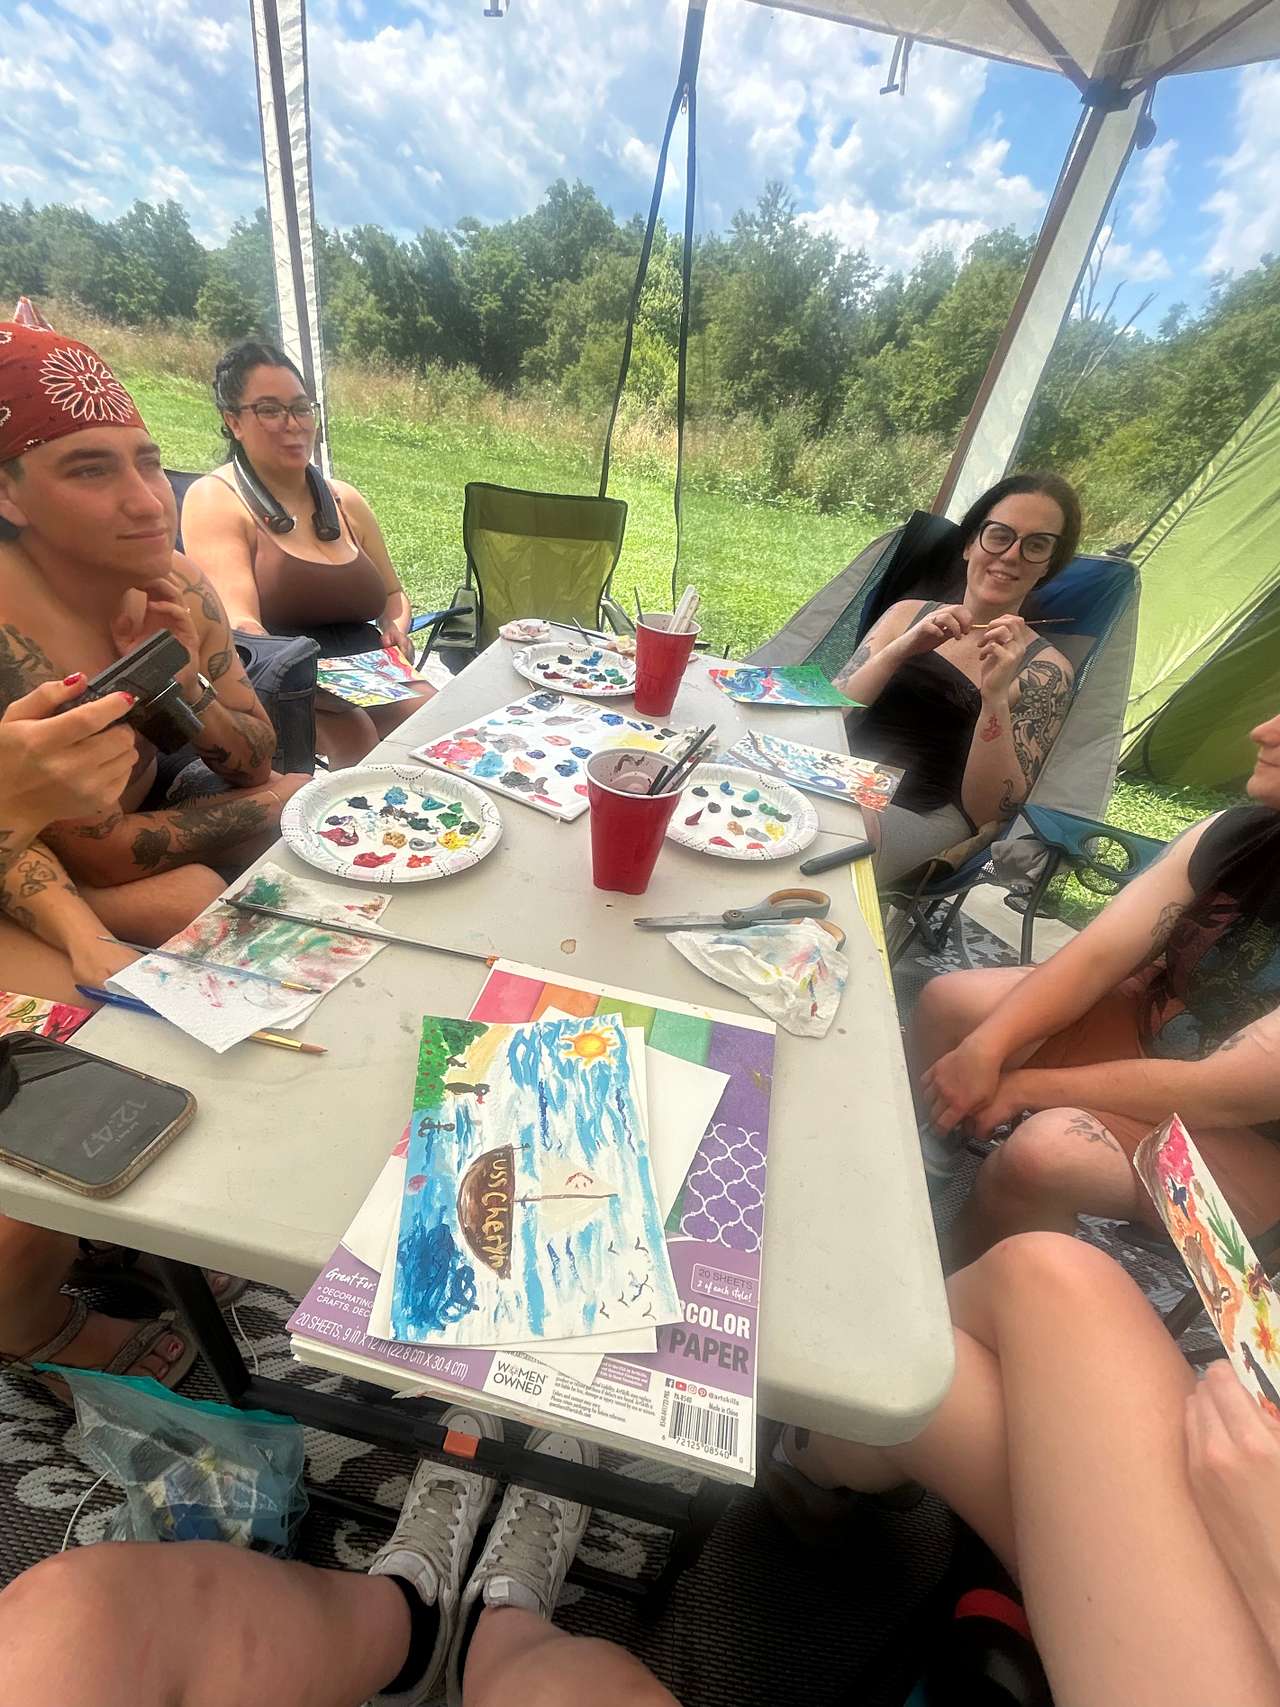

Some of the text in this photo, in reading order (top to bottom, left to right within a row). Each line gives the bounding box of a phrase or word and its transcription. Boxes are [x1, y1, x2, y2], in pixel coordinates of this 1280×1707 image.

[82, 1099, 147, 1159] 12:47
[325, 1268, 377, 1291] Great For:
[698, 1268, 753, 1290] 20 SHEETS
[704, 1281, 713, 1295] of
[713, 1285, 729, 1296] each
[731, 1287, 752, 1303] style!
[316, 1295, 371, 1318] CRAFTS, DEC
[295, 1312, 311, 1327] 20
[307, 1315, 343, 1342] SHEETS,
[342, 1327, 352, 1341] 9
[368, 1336, 380, 1351] 12
[431, 1355, 452, 1373] 30.4
[668, 1327, 749, 1375] PAPER
[493, 1372, 543, 1396] OWNED
[675, 1437, 701, 1450] 72125
[703, 1445, 730, 1459] 08540
